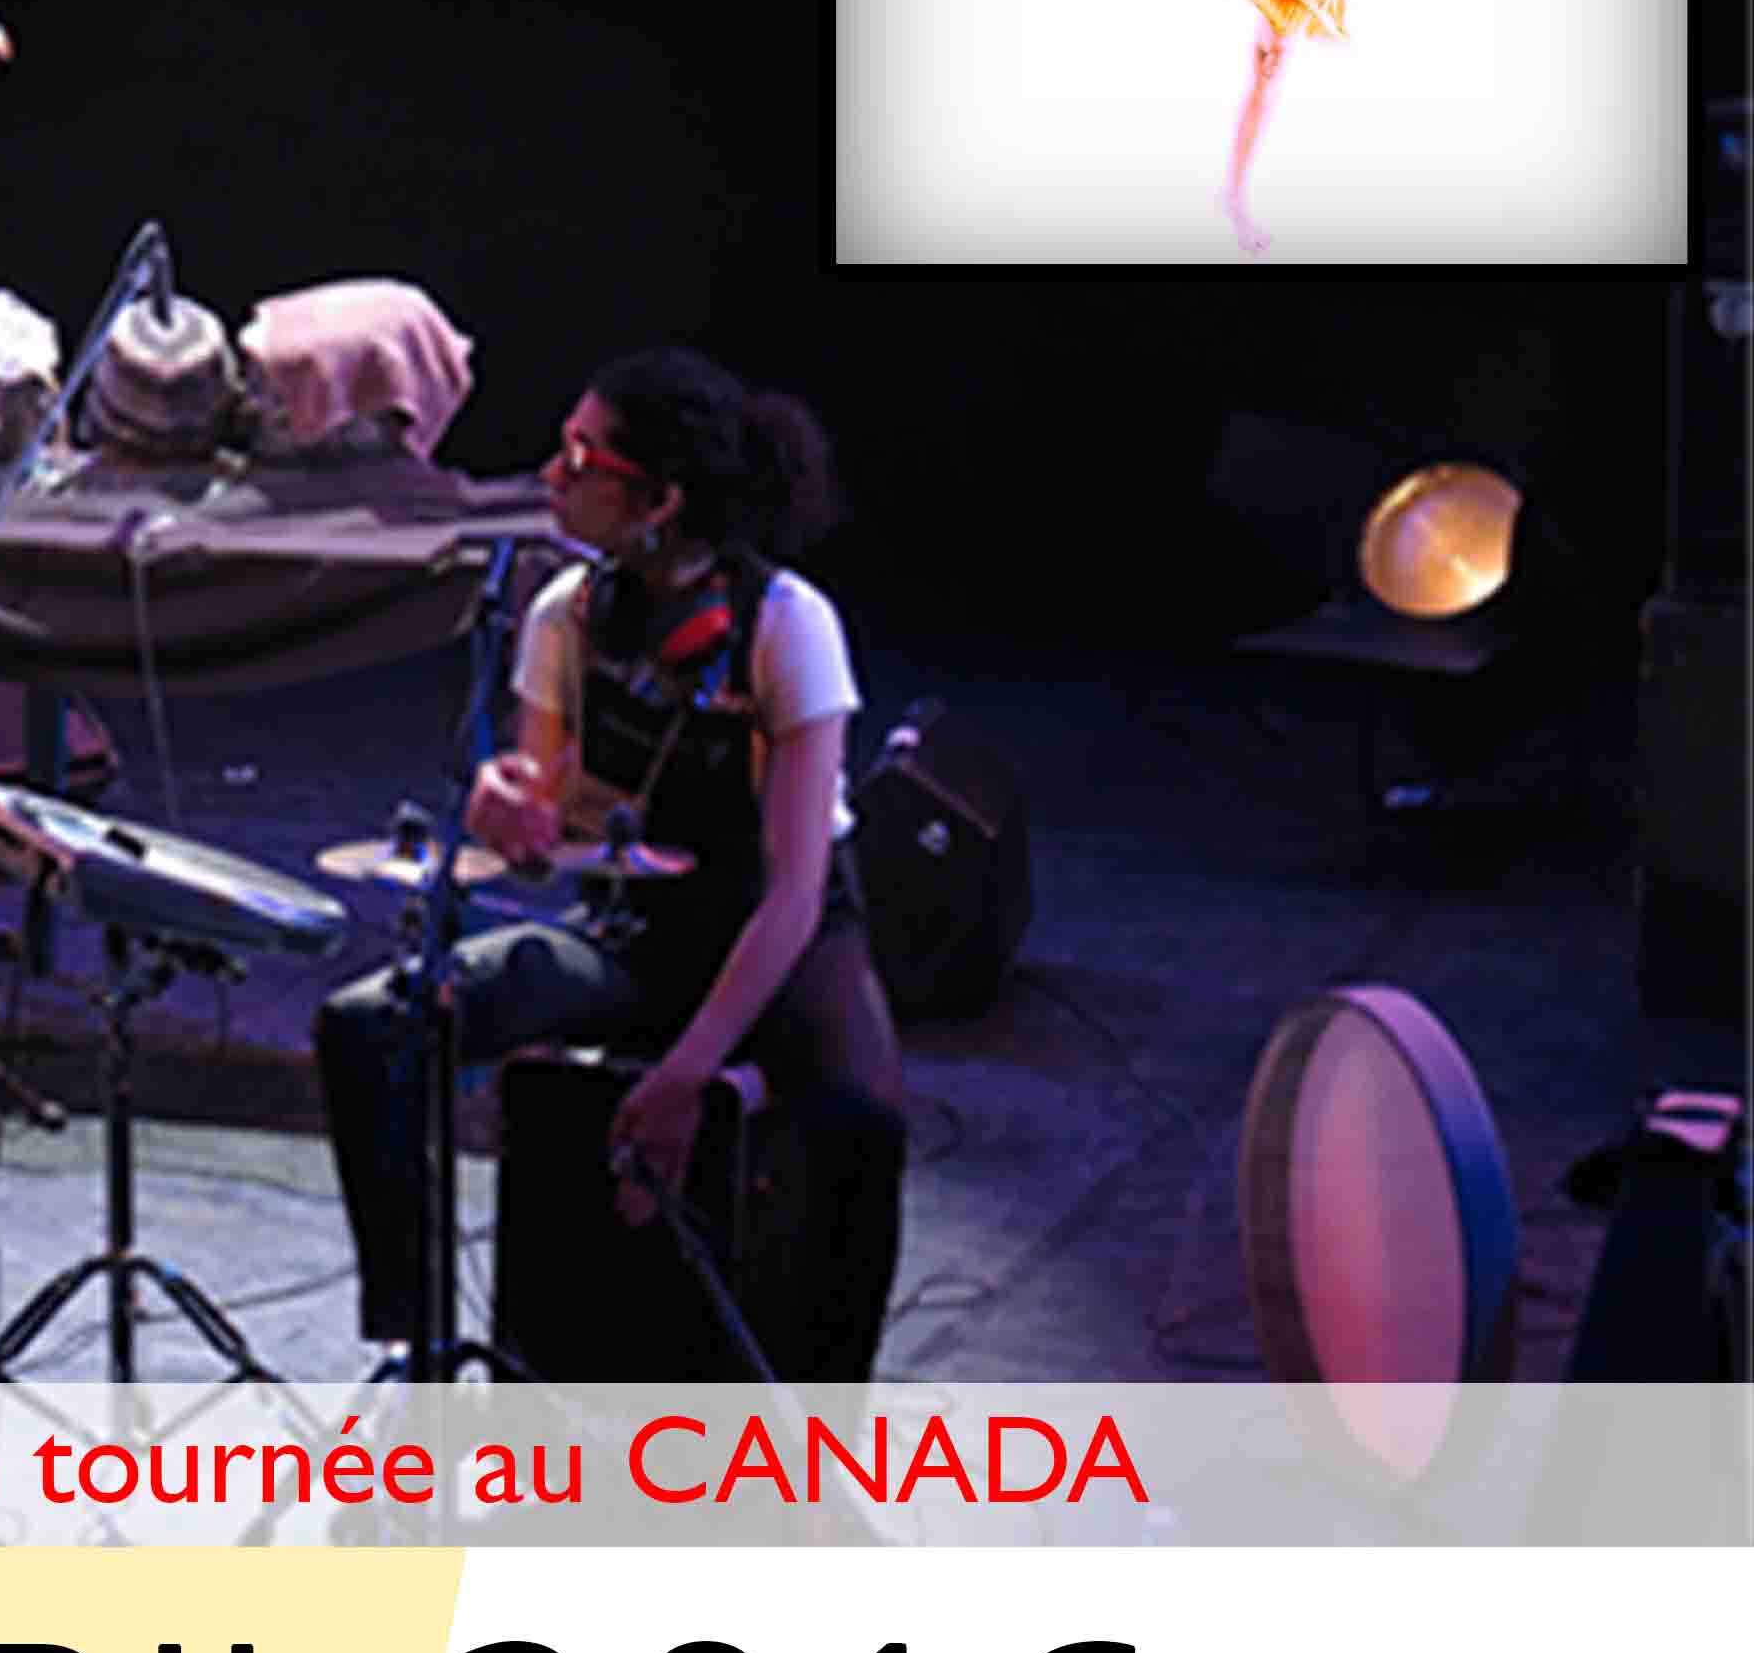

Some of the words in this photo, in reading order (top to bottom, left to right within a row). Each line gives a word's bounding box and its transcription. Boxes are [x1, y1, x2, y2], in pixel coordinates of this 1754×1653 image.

[33, 1415, 434, 1504] tournée
[475, 1444, 582, 1504] au
[629, 1415, 1150, 1504] CANADA
